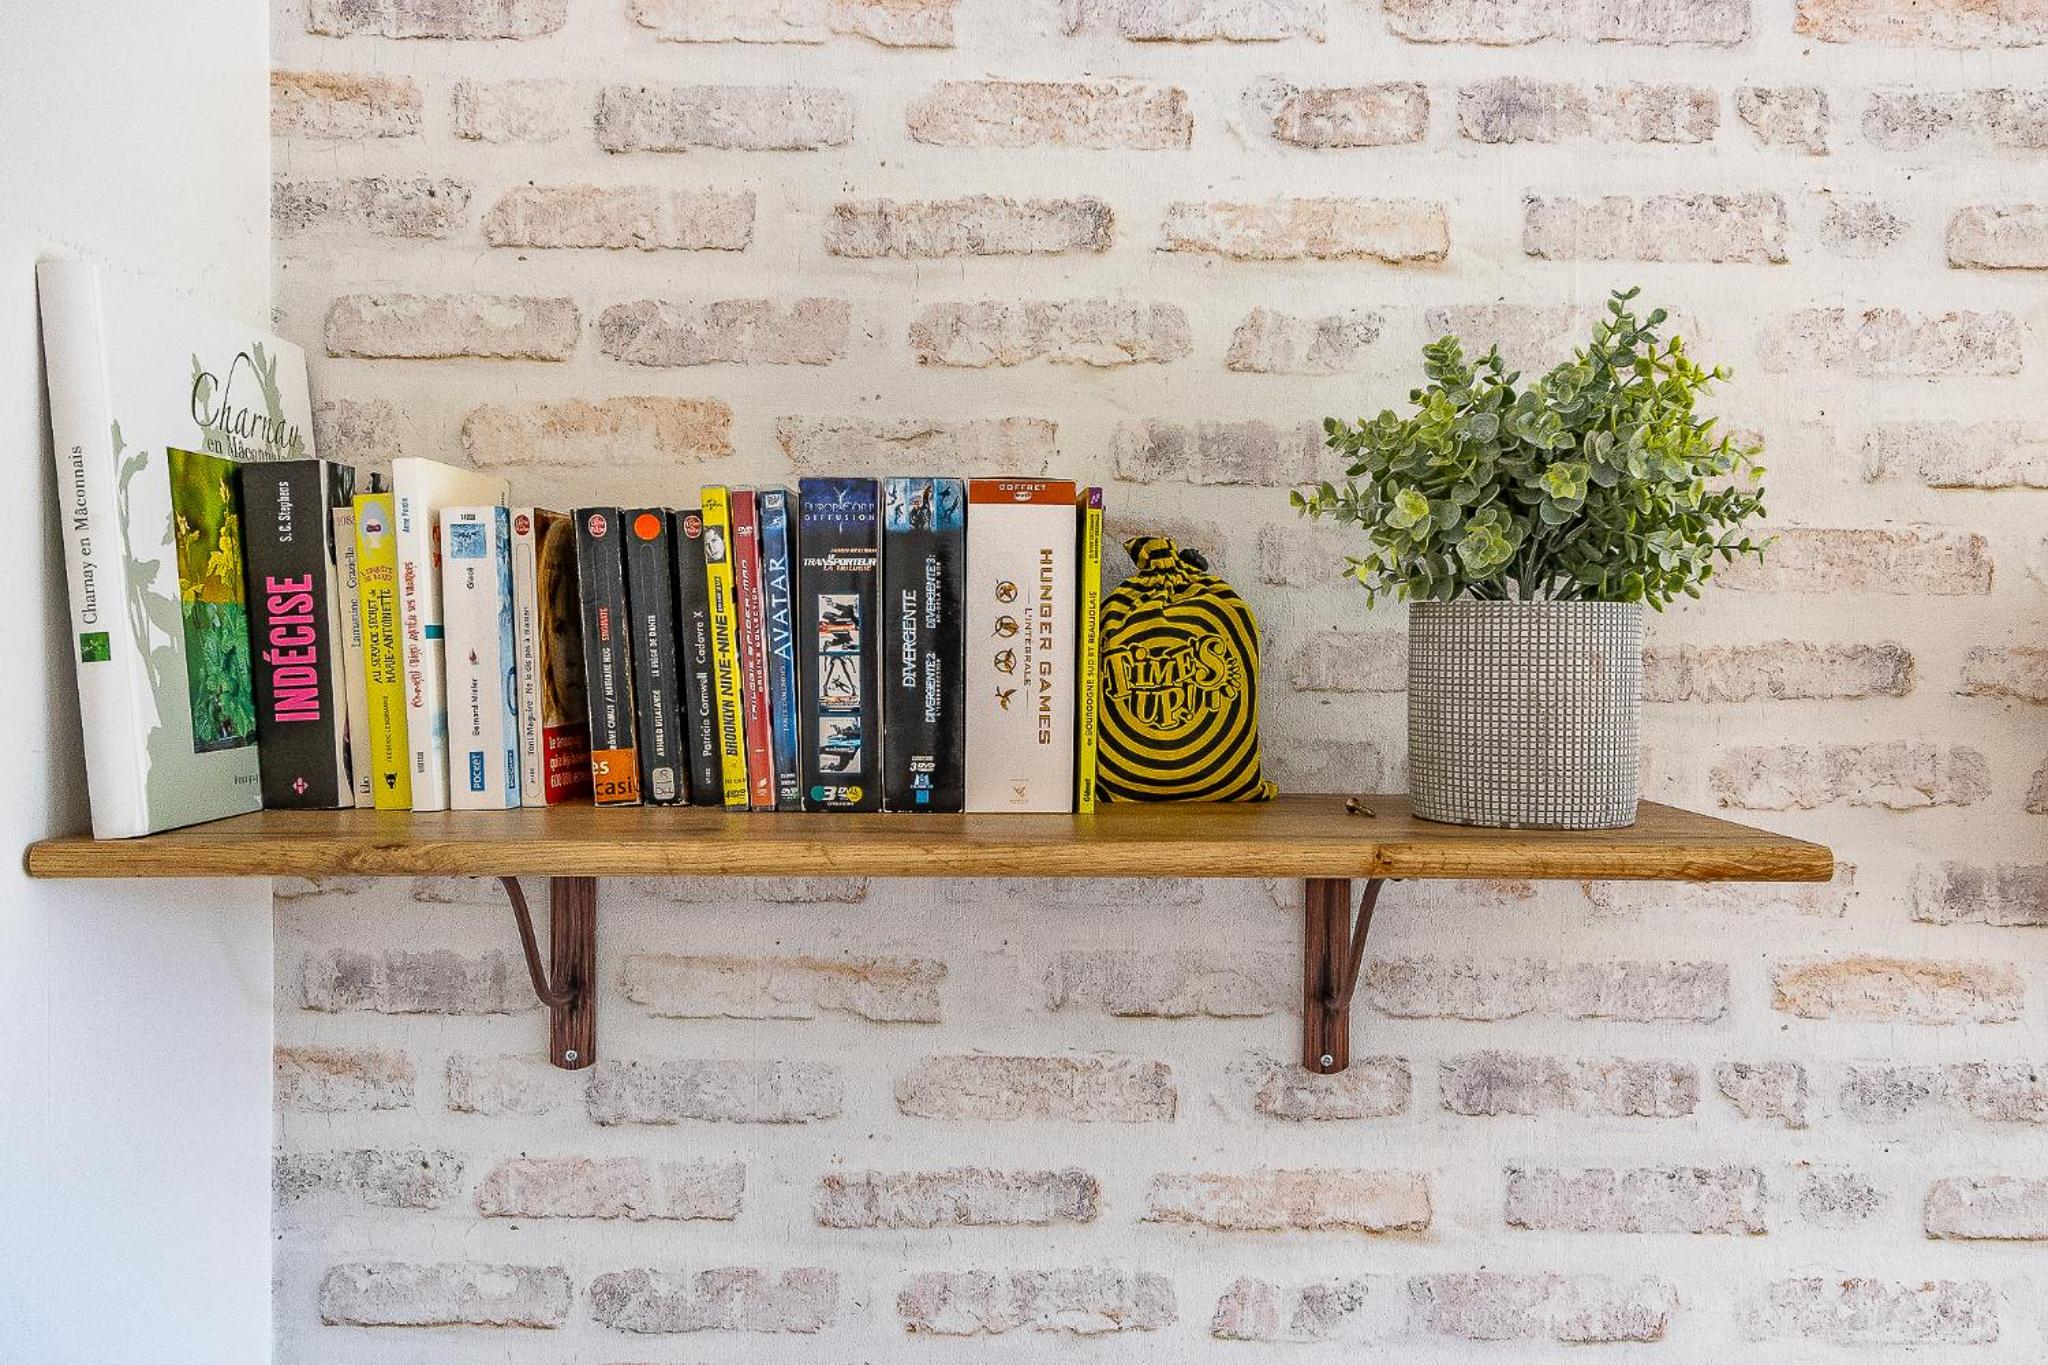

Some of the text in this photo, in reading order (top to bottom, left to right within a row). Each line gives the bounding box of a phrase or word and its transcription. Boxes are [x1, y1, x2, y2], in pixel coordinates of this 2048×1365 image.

[191, 352, 299, 449] Charnay
[206, 437, 223, 454] en
[72, 445, 98, 625] Charnay en Mâconnais
[770, 557, 790, 660] AVATAR
[1088, 590, 1097, 644] BEAUJOLAIS
[262, 574, 321, 722] INDÉCISE
[694, 621, 706, 664] Cadavre
[716, 615, 734, 697] NINE-NINE
[902, 590, 917, 688] DIVERGENTE
[1038, 549, 1053, 745] HUNGER GAMES
[696, 672, 709, 716] Cornwell
[1087, 659, 1095, 677] SUD
[722, 700, 738, 757] BROOKLYN
[1086, 679, 1095, 736] BOURGOGNE
[1136, 684, 1196, 727] UP!
[701, 720, 712, 757] Patricia
[822, 785, 837, 801] 3
[909, 762, 917, 772] 3
